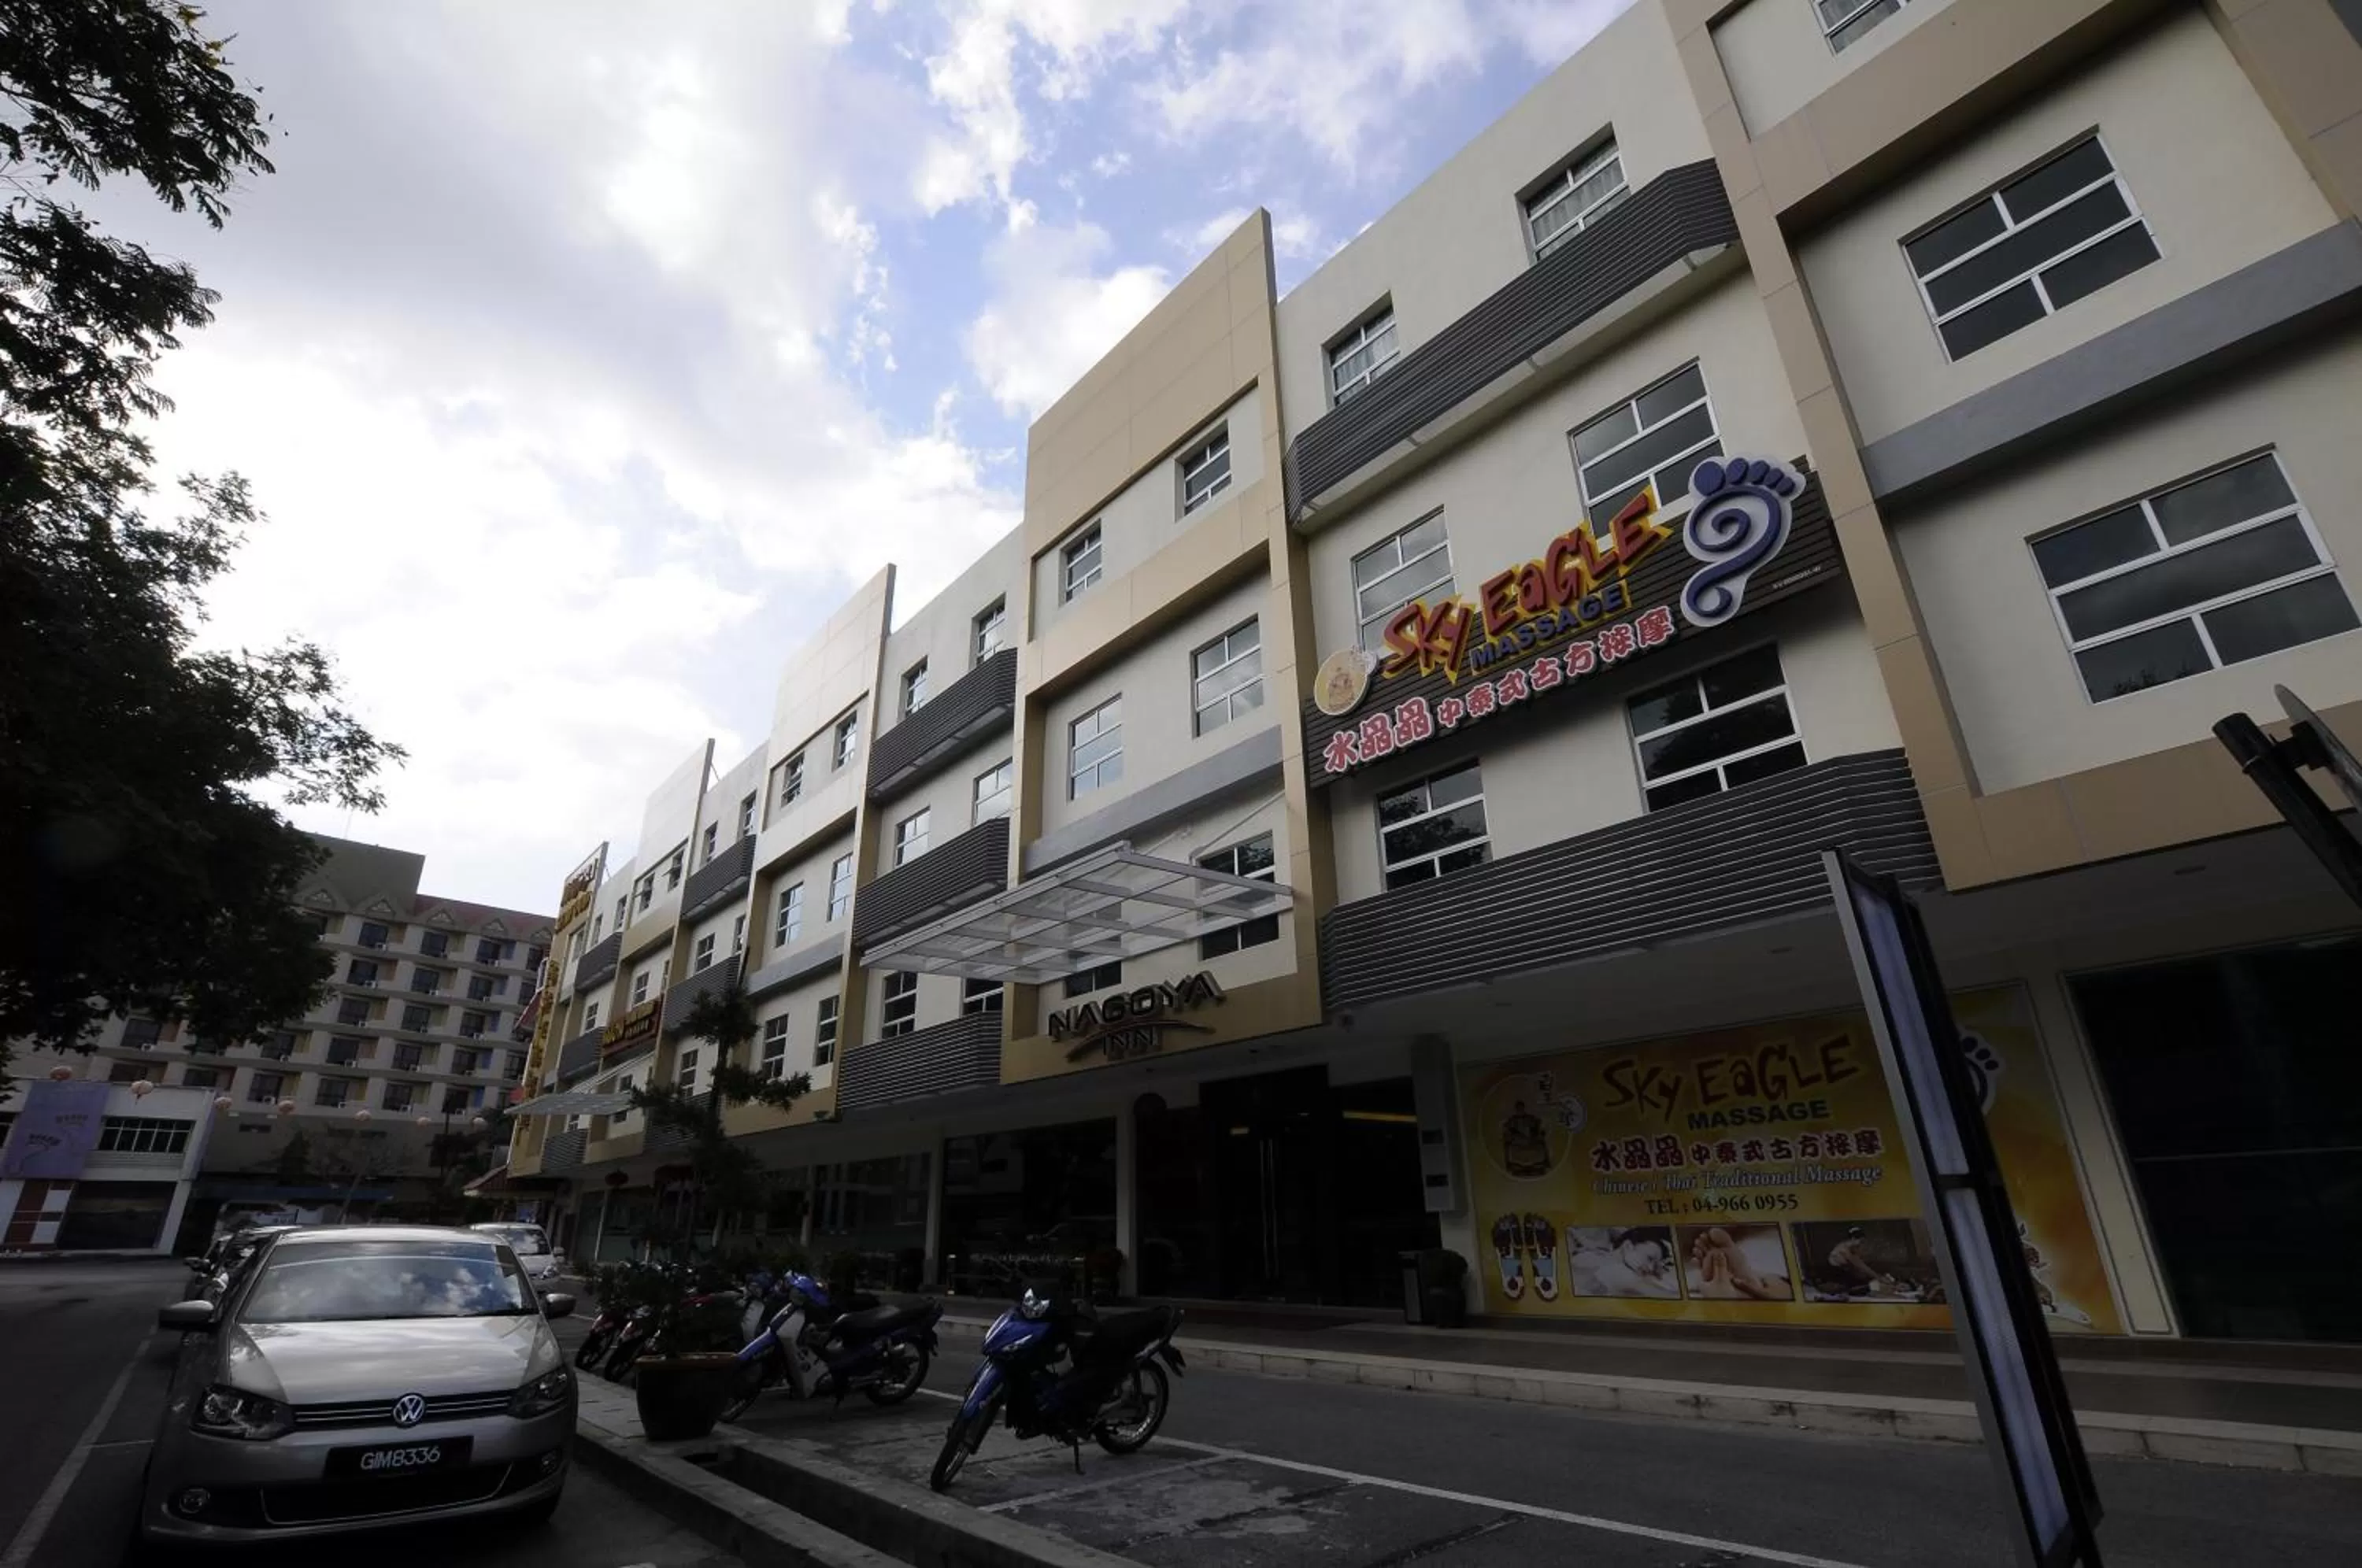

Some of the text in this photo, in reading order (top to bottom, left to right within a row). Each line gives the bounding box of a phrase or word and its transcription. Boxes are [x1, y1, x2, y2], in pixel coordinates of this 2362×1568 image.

[1469, 586, 1626, 668] MASSAGE
[1049, 971, 1226, 1041] NAGOYA
[1102, 1026, 1161, 1058] INN
[1686, 1100, 1830, 1130] MASSAGE
[1703, 1165, 1800, 1189] Traditional
[1802, 1163, 1882, 1186] Massage
[1692, 1196, 1750, 1211] 04-966
[1754, 1193, 1799, 1210] 0955
